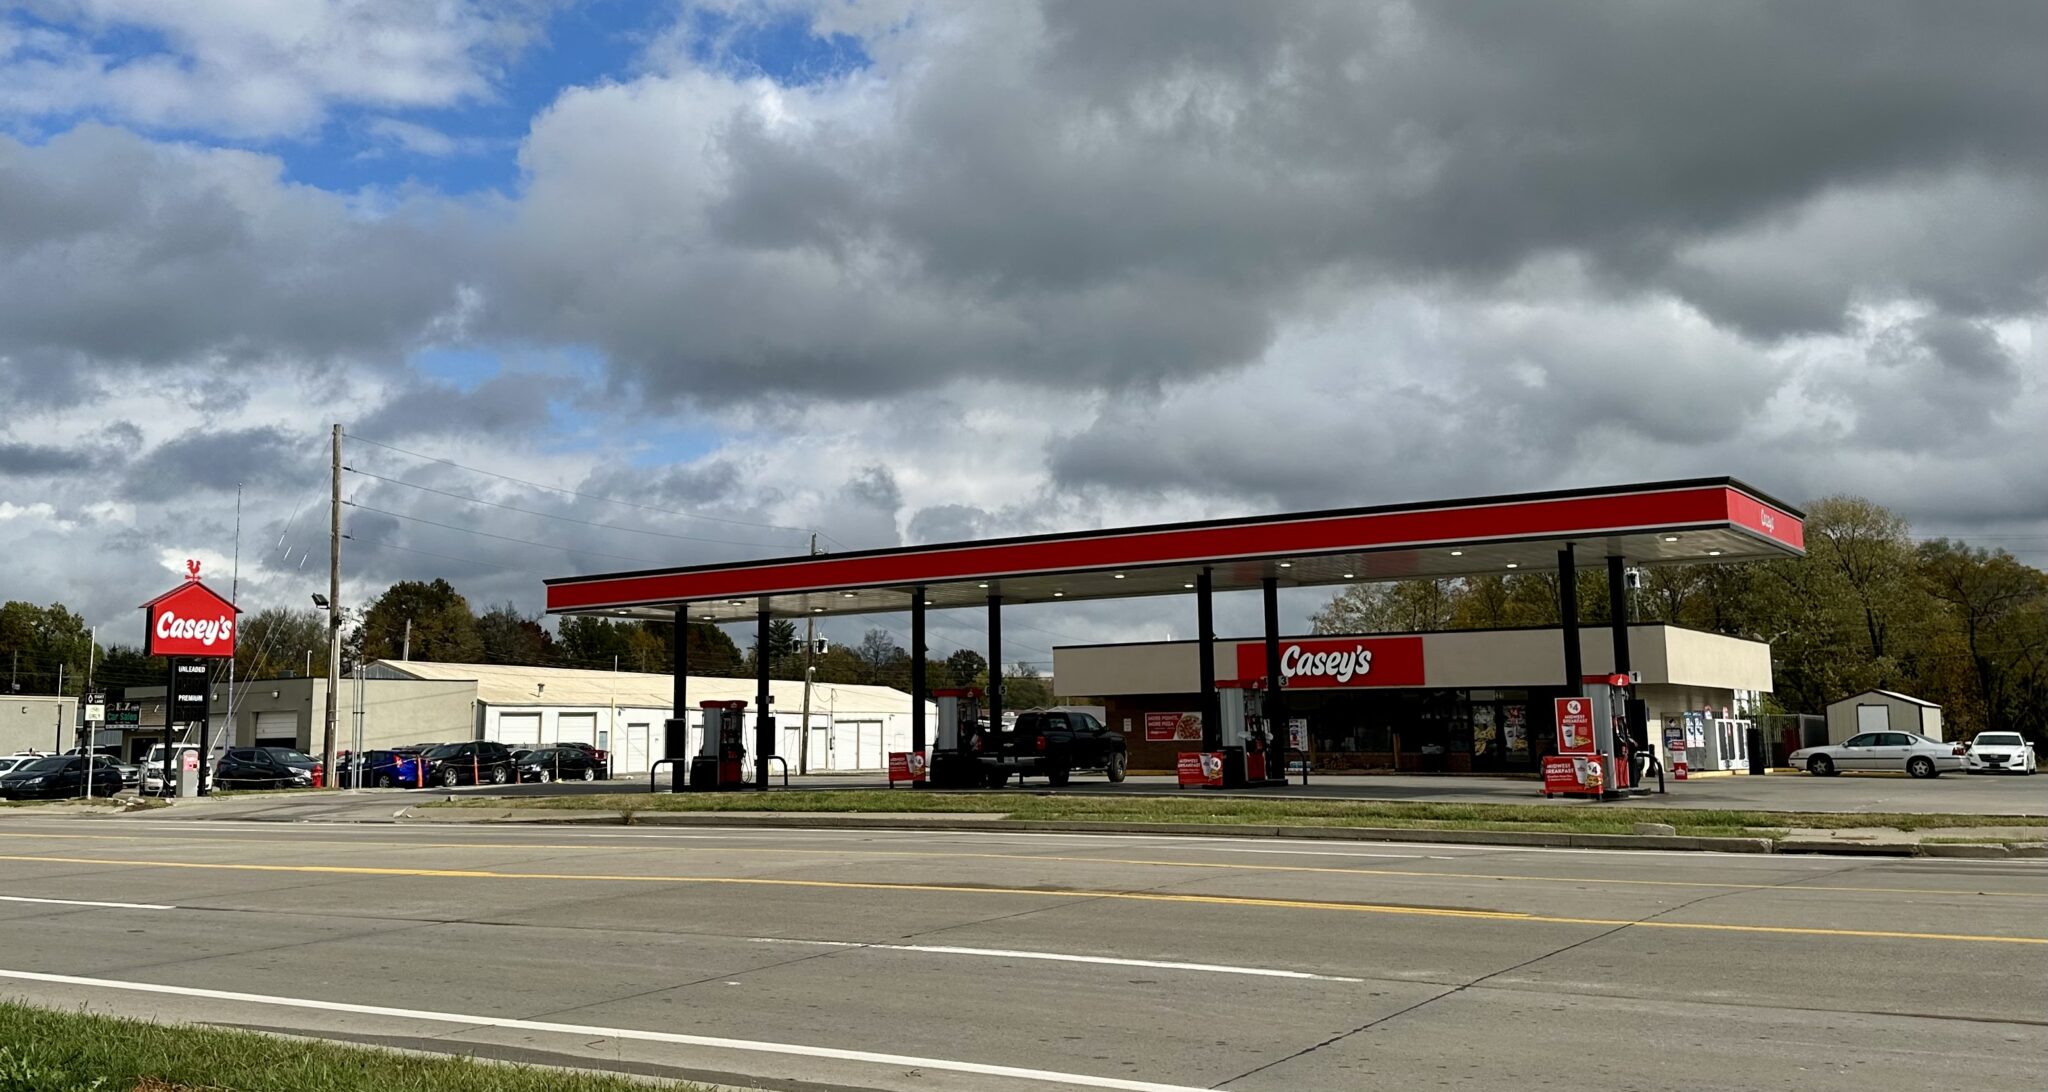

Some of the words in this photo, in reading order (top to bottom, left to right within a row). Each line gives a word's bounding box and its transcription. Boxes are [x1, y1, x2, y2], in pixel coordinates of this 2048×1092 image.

[156, 611, 233, 646] Casey's
[178, 665, 206, 673] UNLEADED
[1280, 645, 1372, 683] Casey's
[1281, 677, 1287, 685] 3
[1632, 672, 1638, 682] 1
[1588, 765, 1598, 775] $4
